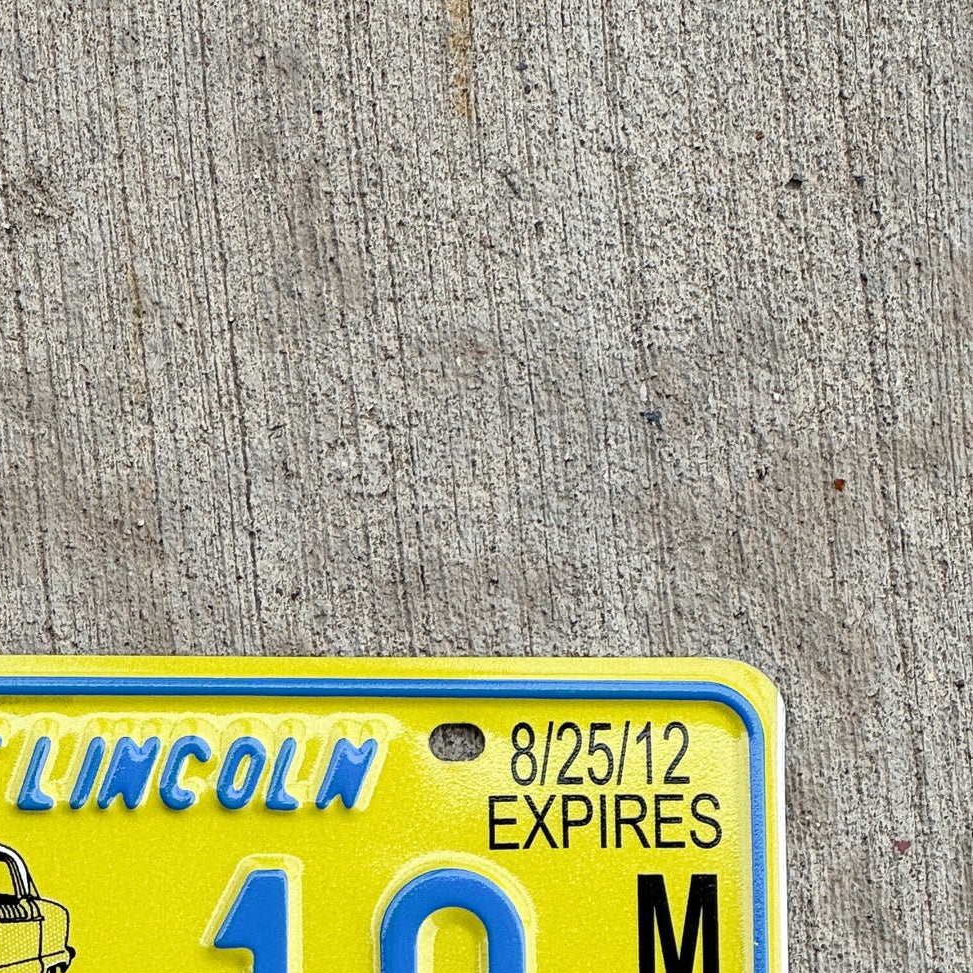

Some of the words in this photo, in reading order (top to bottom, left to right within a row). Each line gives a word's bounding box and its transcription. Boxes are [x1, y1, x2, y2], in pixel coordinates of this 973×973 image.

[16, 735, 379, 812] LINCOLN
[510, 720, 691, 786] 8/25/12
[487, 793, 723, 851] EXPIRES
